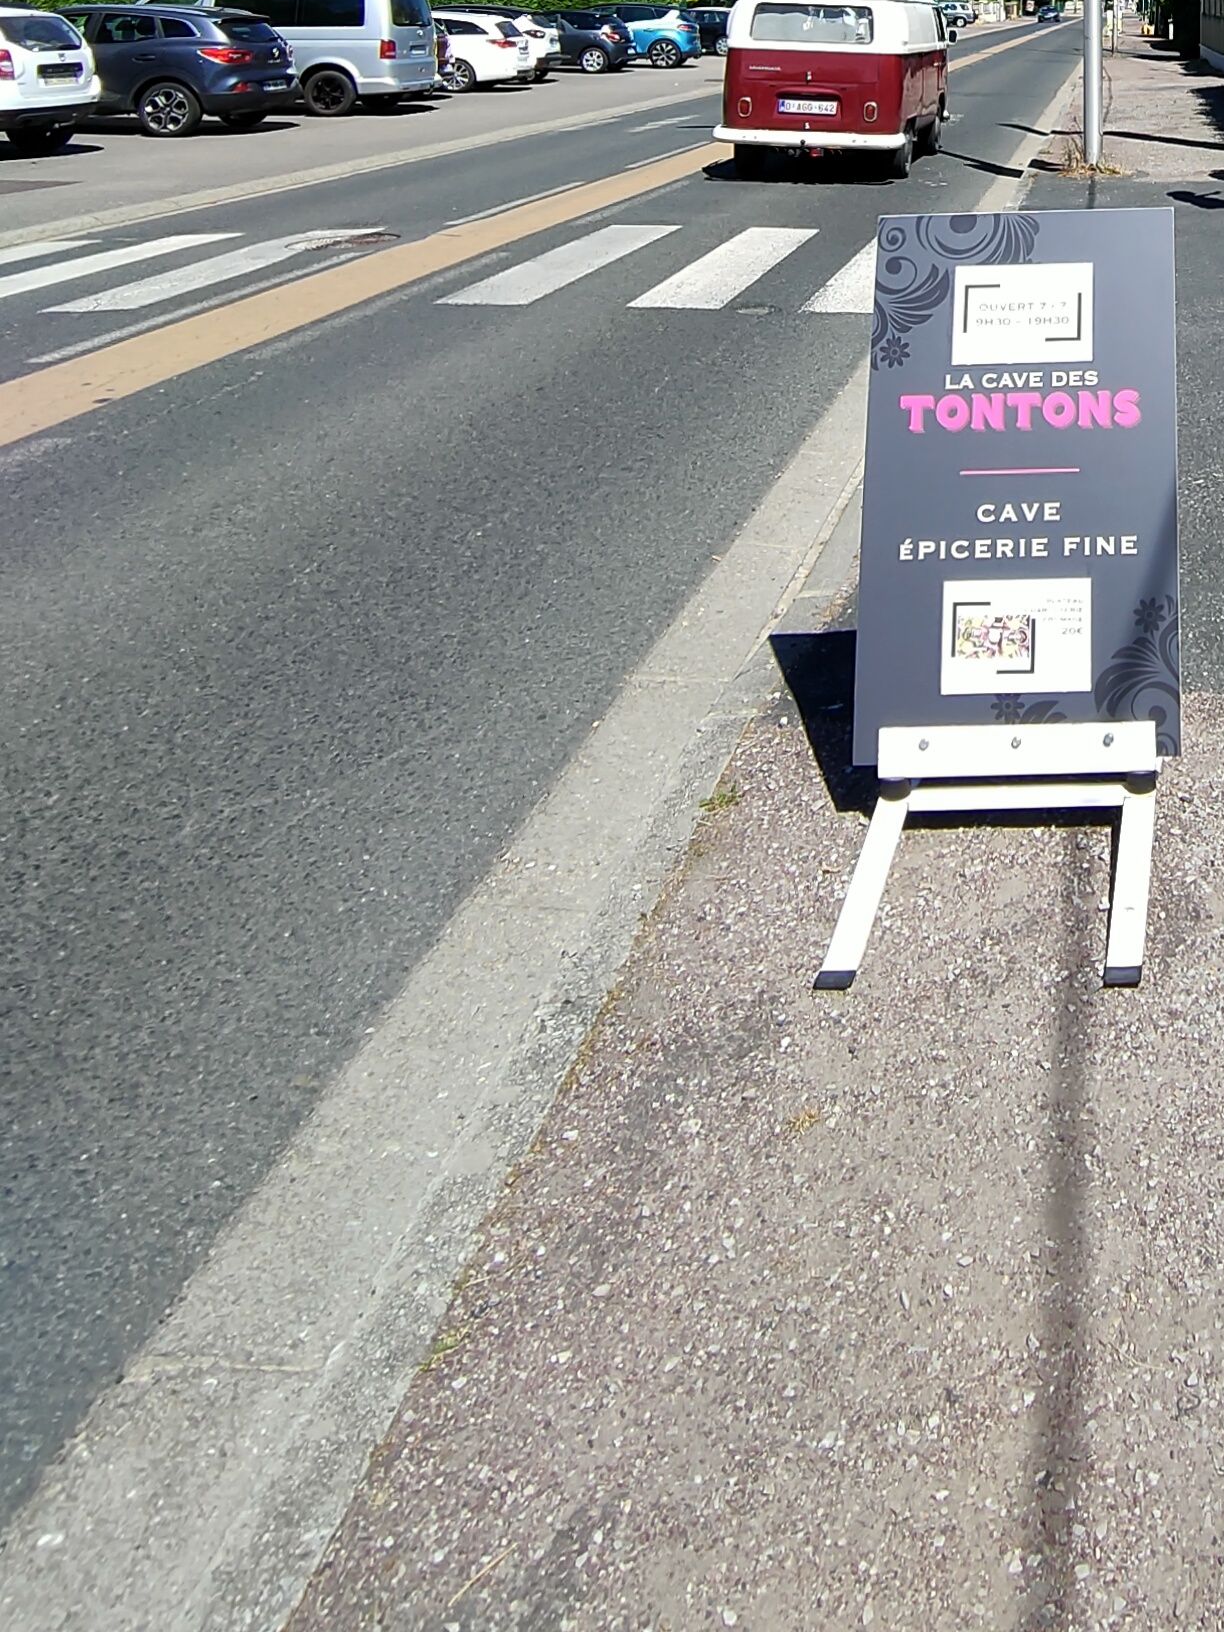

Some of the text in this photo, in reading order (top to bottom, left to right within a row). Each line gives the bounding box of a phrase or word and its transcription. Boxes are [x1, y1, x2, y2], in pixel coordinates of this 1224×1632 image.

[979, 302, 1034, 311] OUVERT
[976, 317, 1011, 326] 9H30
[1028, 316, 1070, 325] 19H30
[944, 370, 1099, 390] LA CAVE DES
[900, 389, 1142, 433] TONTONS
[976, 502, 1061, 523] CAVE
[898, 535, 1138, 561] ÉPICERIE FINE
[1062, 627, 1083, 635] 20€
